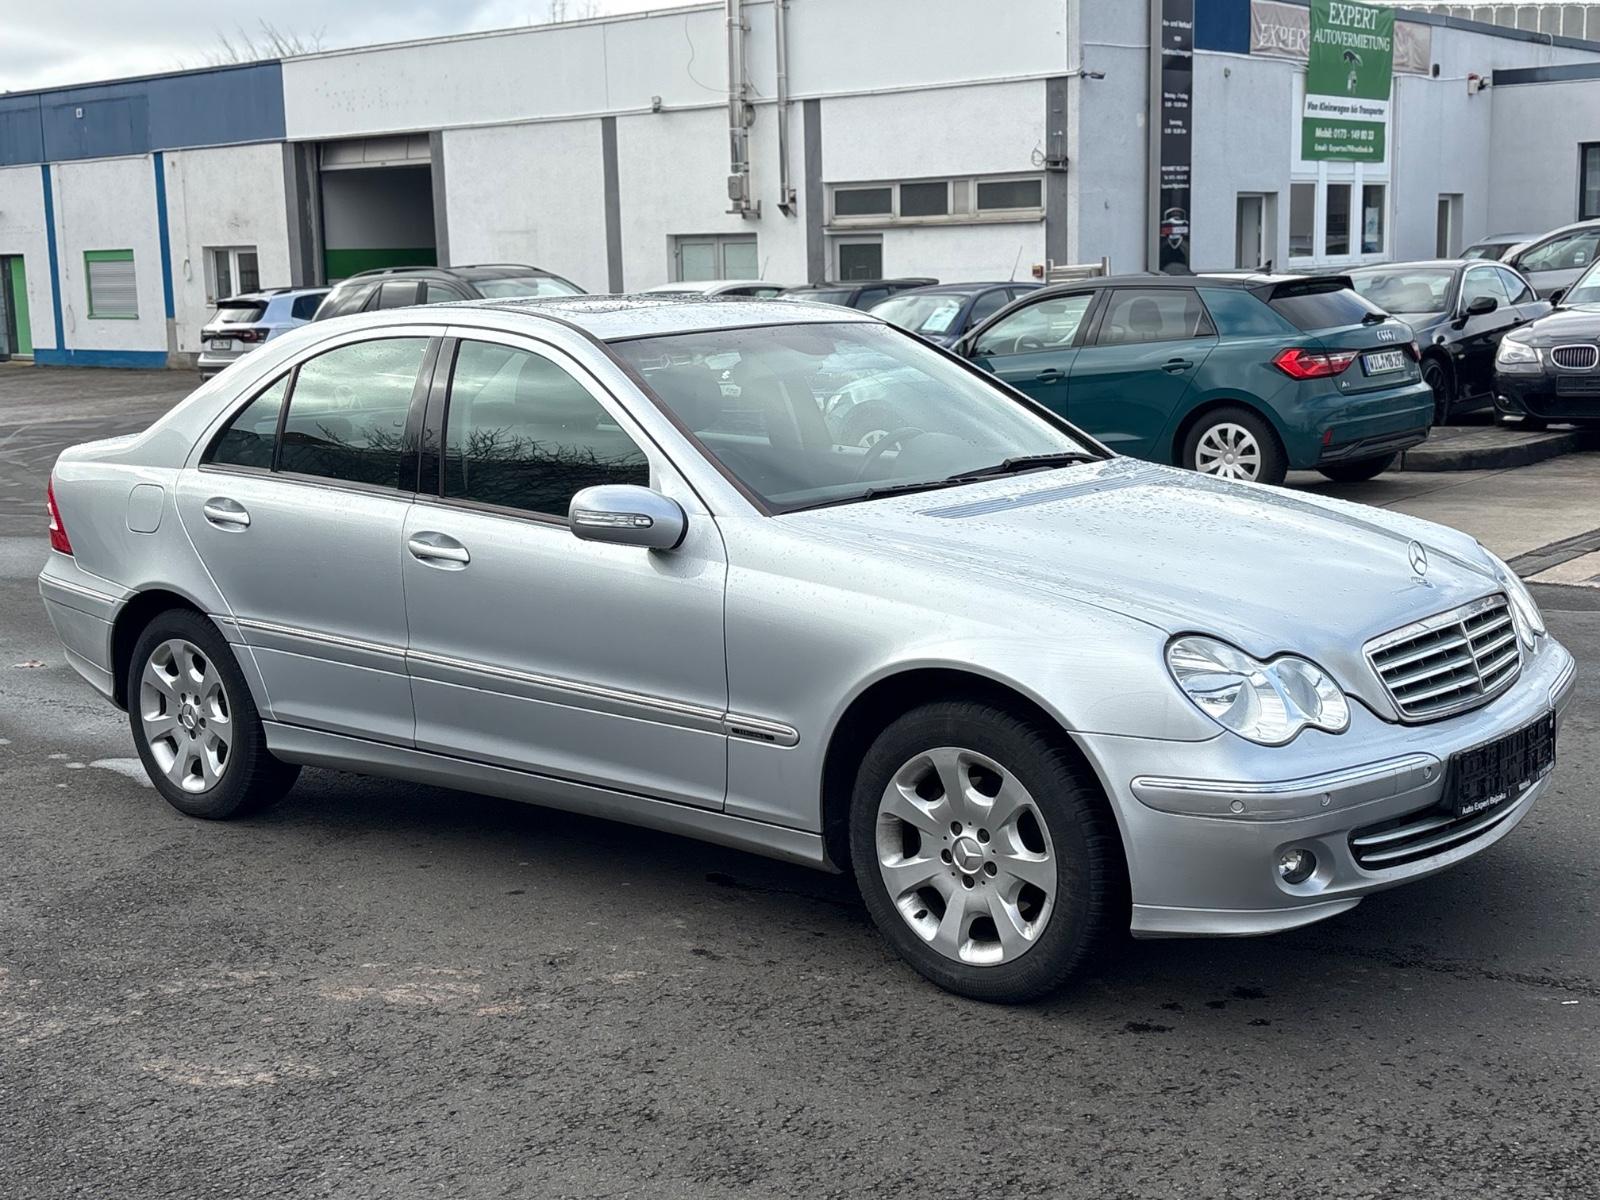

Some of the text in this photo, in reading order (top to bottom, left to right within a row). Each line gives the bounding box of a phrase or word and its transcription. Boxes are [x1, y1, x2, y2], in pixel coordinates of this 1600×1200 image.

[1328, 2, 1379, 30] EXPERT
[1257, 23, 1310, 52] EXPER
[1313, 28, 1390, 52] AUTOVERMIETUNG
[1307, 101, 1318, 111] Von
[1319, 102, 1350, 115] Kleinwagen
[1359, 105, 1385, 117] Transporter
[1462, 805, 1474, 815] Auto
[1474, 799, 1490, 811] Expert
